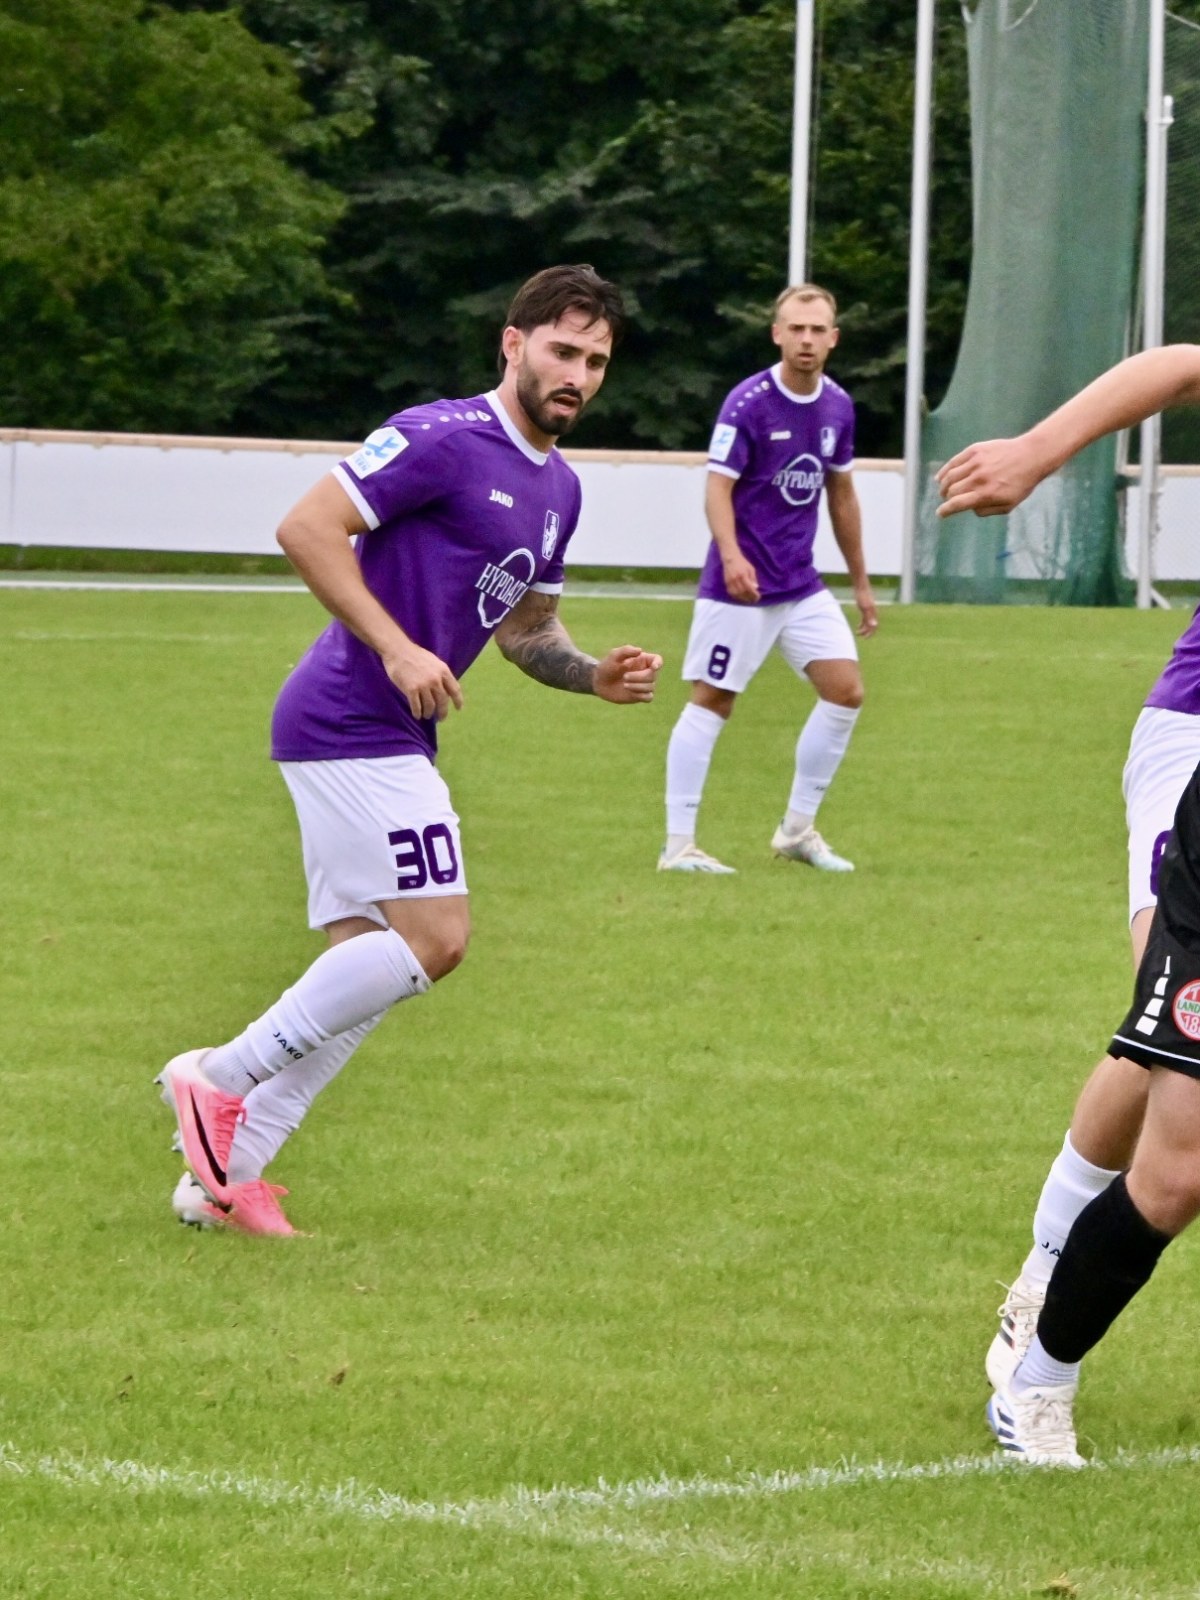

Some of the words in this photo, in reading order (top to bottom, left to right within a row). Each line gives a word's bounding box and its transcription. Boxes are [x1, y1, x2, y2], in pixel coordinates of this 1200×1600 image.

[489, 489, 513, 508] JAKO
[707, 644, 731, 681] 8
[388, 823, 458, 891] 30
[273, 1031, 304, 1060] JAKO
[1041, 1241, 1061, 1258] JA
